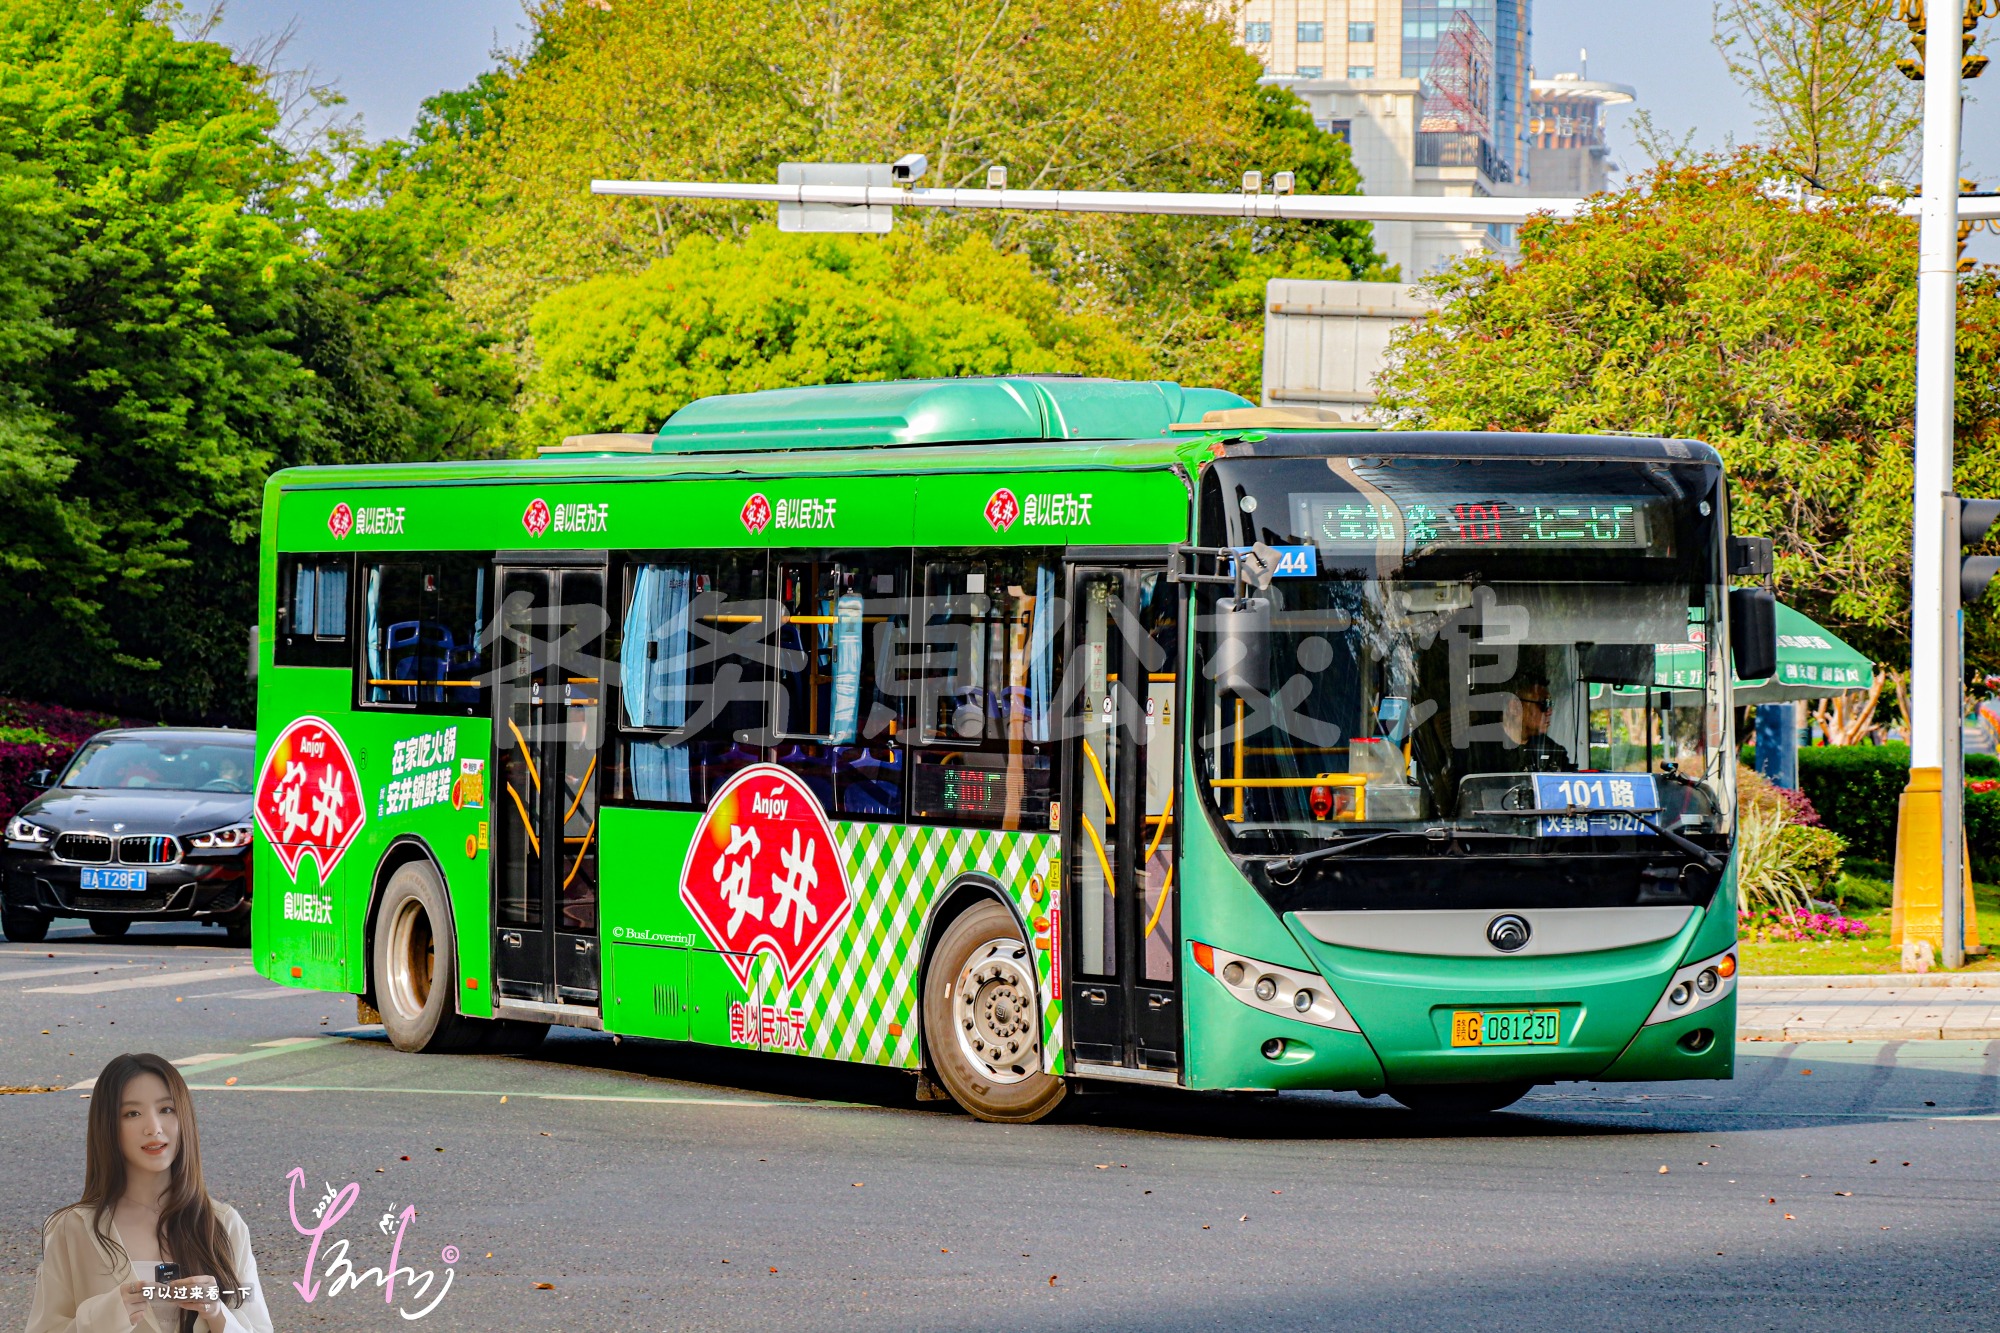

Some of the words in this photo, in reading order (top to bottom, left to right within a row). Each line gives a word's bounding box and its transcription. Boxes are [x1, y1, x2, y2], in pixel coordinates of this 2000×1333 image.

[355, 507, 406, 534] 食以民为天
[553, 503, 609, 532] 食以民为天
[775, 498, 837, 529] 食以民为天
[1023, 493, 1093, 526] 食以民为天
[299, 735, 326, 759] Anjoy
[391, 726, 457, 775] 在家吃火锅
[272, 761, 344, 850] 安井
[386, 767, 452, 815] 安井锁鲜装
[752, 791, 789, 821] Anjoy
[1558, 779, 1635, 808] 101路
[712, 823, 819, 947] 安井
[284, 891, 333, 925] 食以民为天
[730, 1002, 807, 1050] 食以民为天
